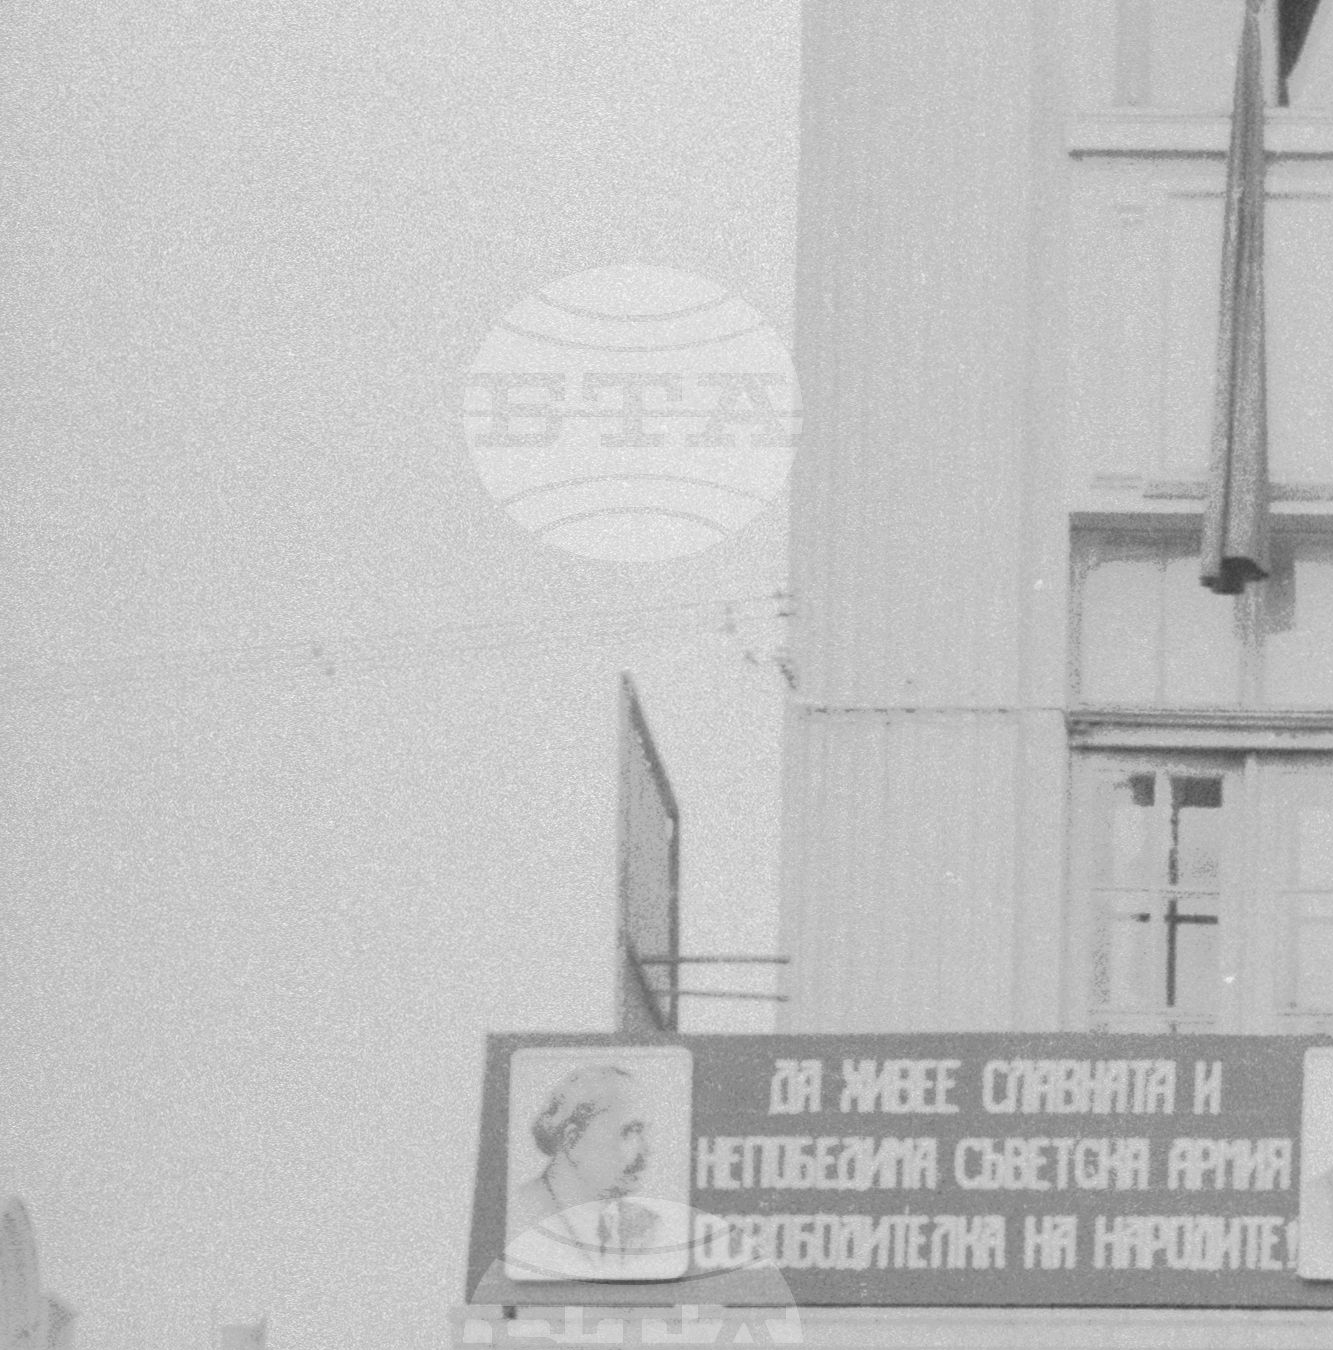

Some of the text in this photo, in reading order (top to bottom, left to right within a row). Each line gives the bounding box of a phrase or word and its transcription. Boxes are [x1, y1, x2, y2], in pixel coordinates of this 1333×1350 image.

[768, 1058, 1222, 1115] ДА ЖИВЕЕ СЛАВНАТА И
[697, 1136, 1293, 1191] НЕПОБЕДИМА СЪВЕТСКА АРМИЯ
[693, 1213, 1006, 1270] ОСВОБОДИТЕЛКА
[1023, 1214, 1078, 1270] НА
